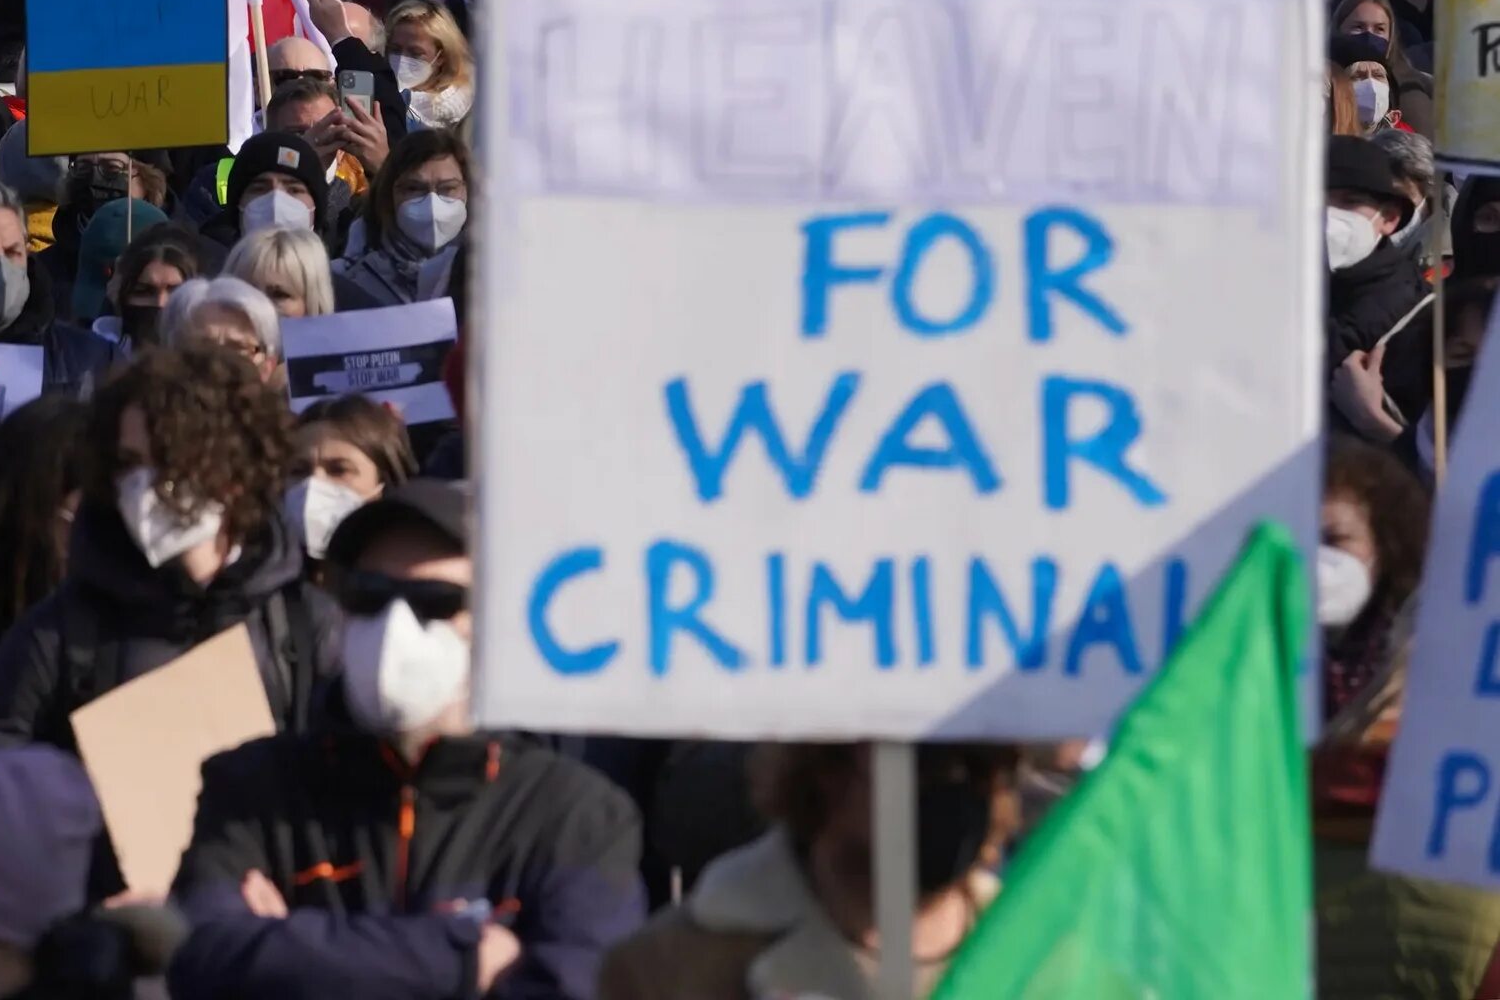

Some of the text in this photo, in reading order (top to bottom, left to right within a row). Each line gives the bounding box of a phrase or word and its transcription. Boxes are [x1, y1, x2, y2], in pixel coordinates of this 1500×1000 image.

[89, 74, 171, 119] WAR
[798, 206, 1130, 344] FOR
[344, 350, 400, 370] STOP PUTIN
[663, 369, 1170, 512] WAR
